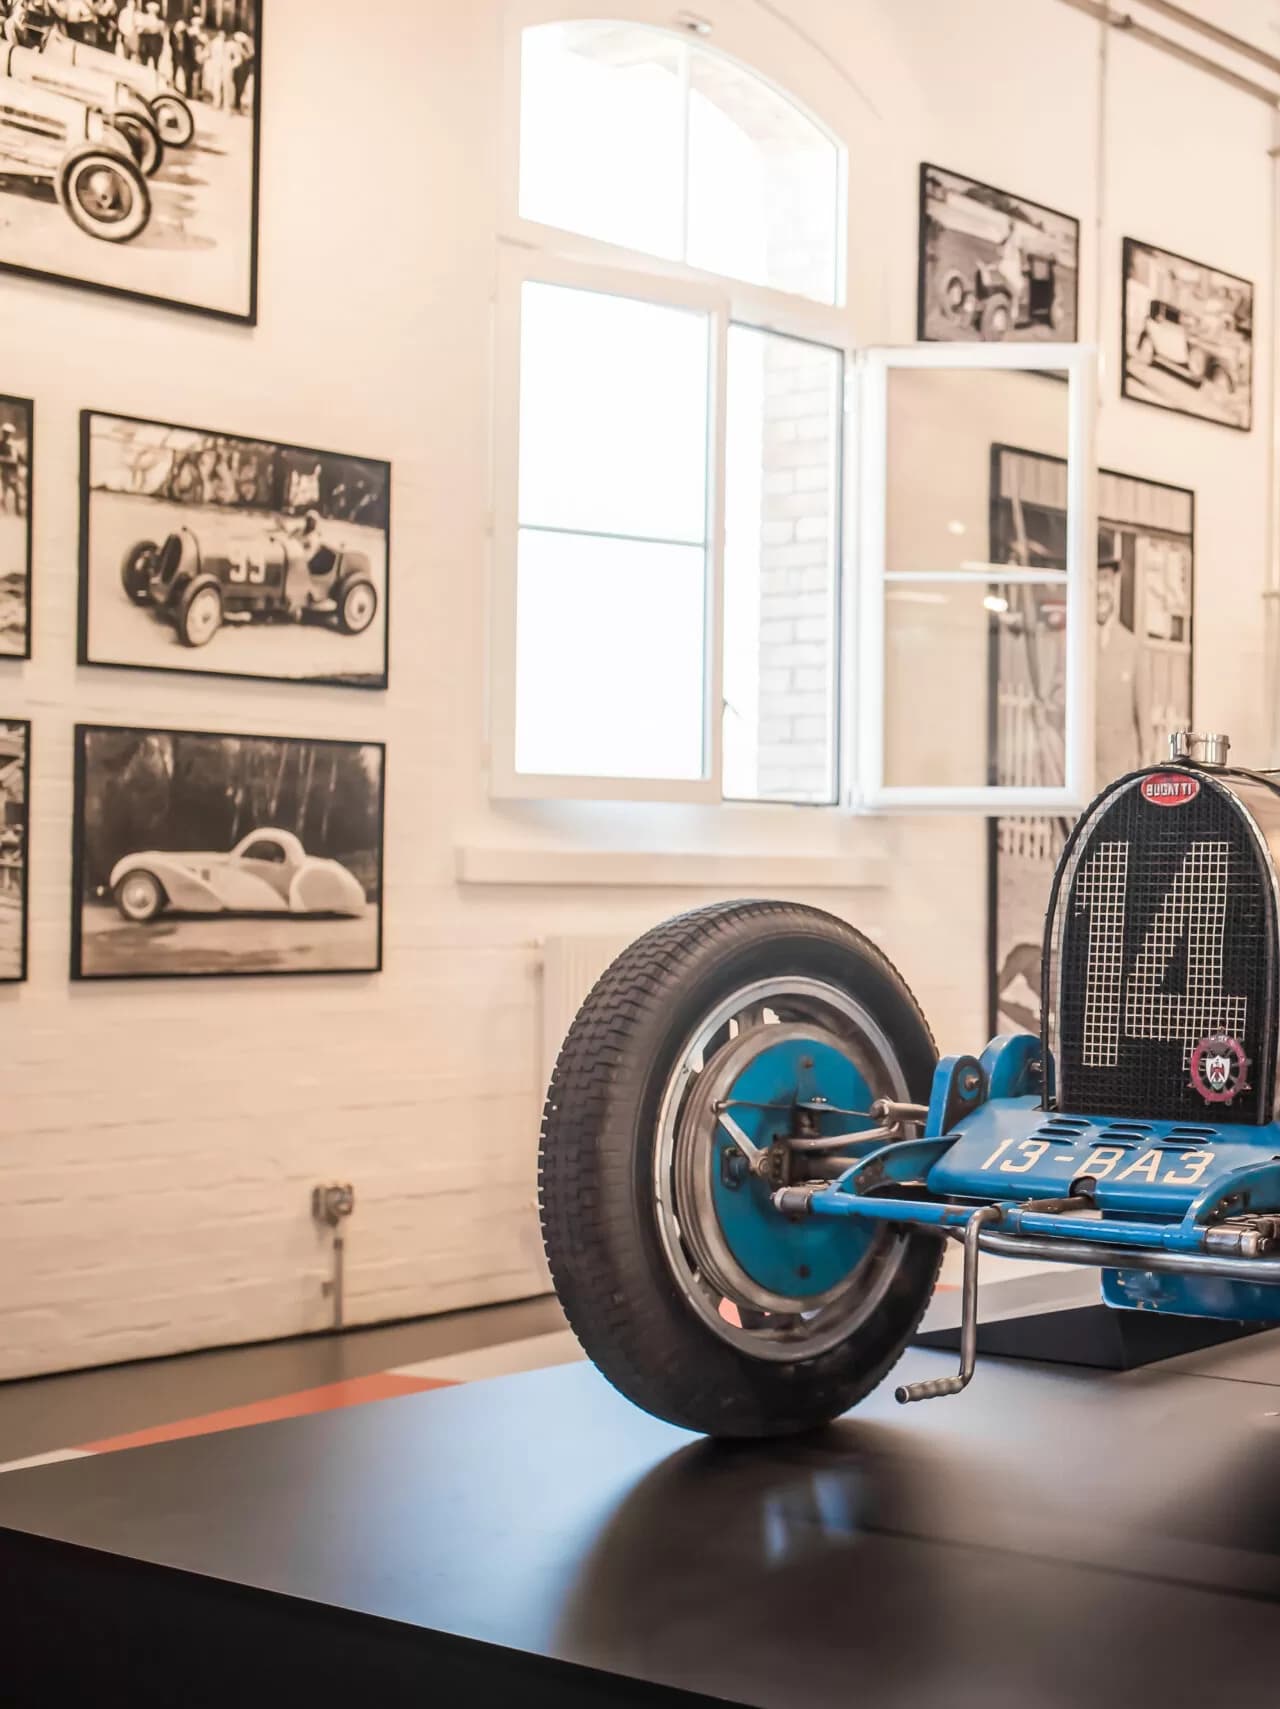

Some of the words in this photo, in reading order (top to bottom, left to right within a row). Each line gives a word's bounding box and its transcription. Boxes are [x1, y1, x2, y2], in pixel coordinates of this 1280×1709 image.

[1146, 783, 1192, 797] BUGATTI
[1075, 841, 1247, 1072] 14
[980, 1138, 1215, 1185] 13-BA3
